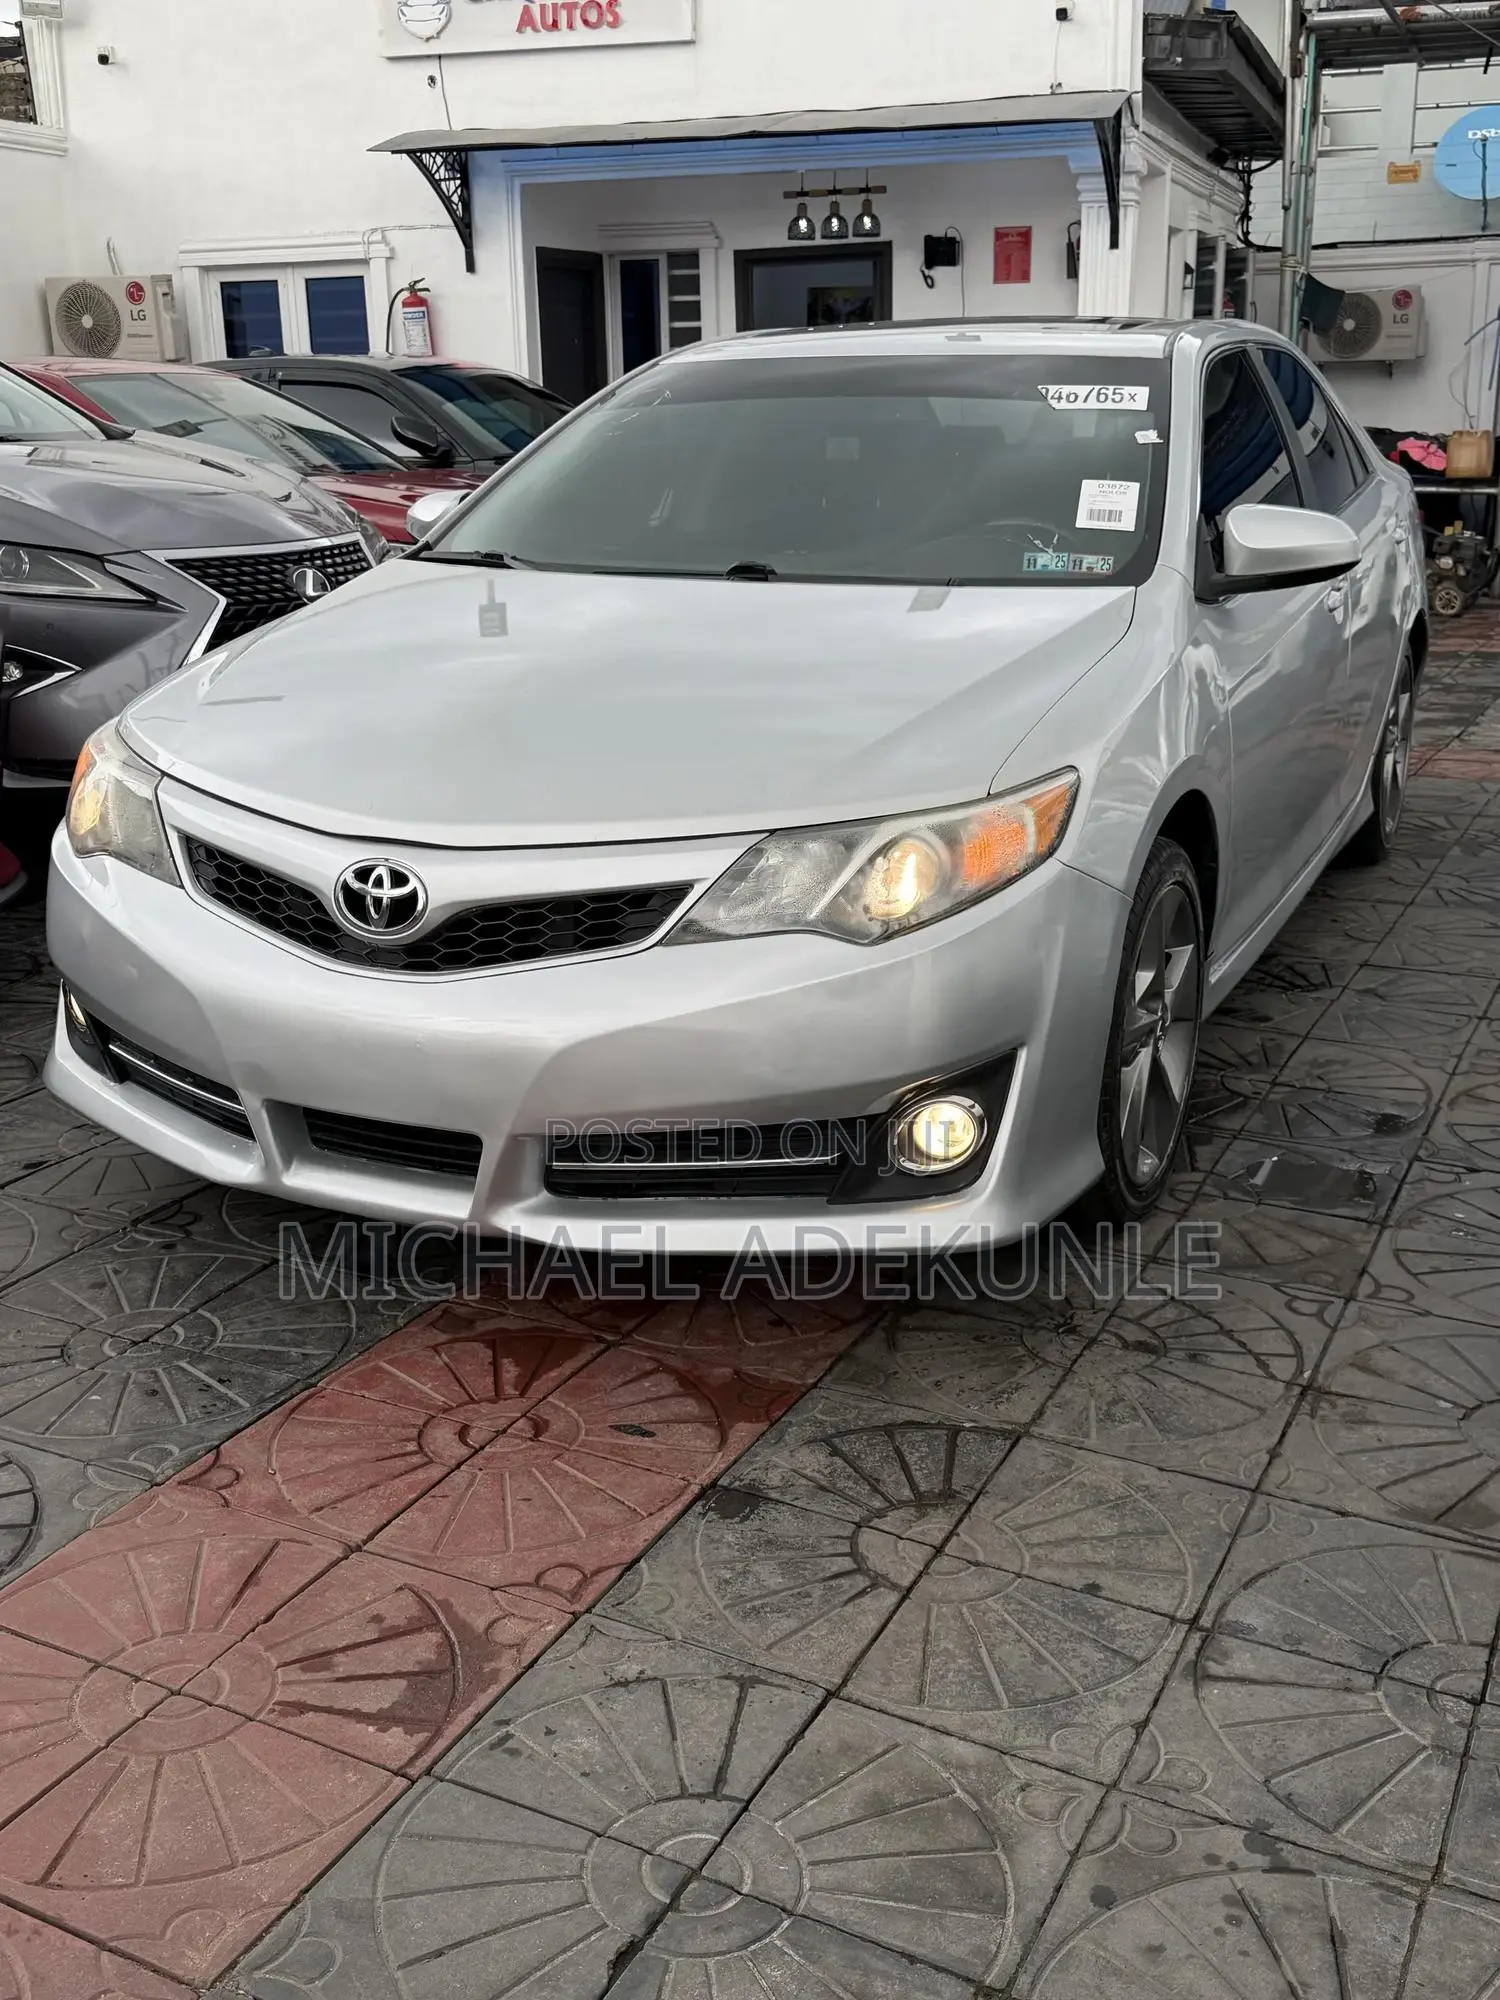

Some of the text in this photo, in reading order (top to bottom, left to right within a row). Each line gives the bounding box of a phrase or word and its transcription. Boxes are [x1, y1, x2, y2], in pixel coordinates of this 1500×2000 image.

[516, 0, 621, 33] AUTOS
[130, 309, 147, 321] LG
[1392, 313, 1409, 324] LG
[1055, 554, 1066, 568] 25
[1100, 557, 1111, 571] 25
